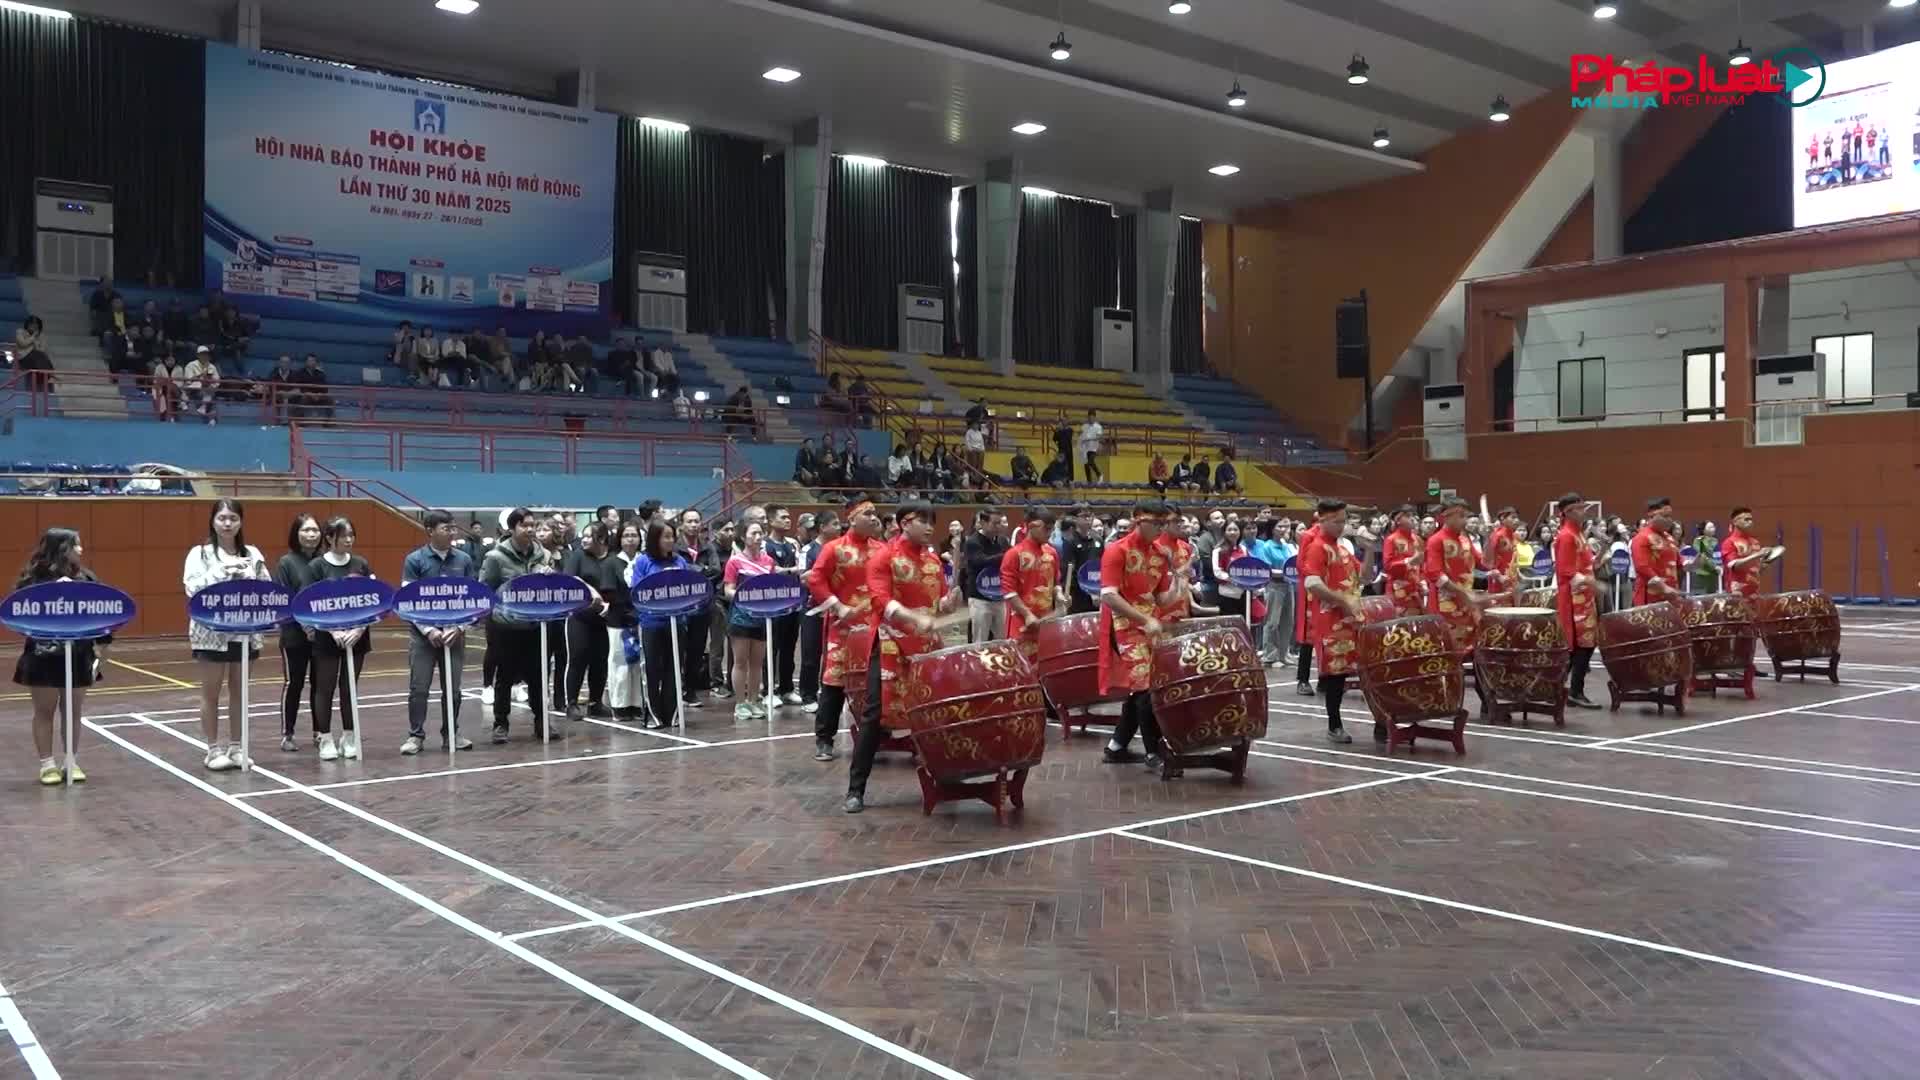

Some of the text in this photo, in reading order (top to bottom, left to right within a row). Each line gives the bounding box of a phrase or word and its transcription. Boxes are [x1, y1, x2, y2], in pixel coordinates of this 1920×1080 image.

[370, 129, 486, 162] HỘI KHỎE
[255, 136, 581, 199] HỘI NHÀ BÁO THÀNH PHỐ HÀ NỘI MỞ RỘNG
[340, 175, 511, 214] LẦN THỨ 30 NĂM 2025
[201, 590, 288, 609] TẠP CHÍ ĐỜI SỐNG
[419, 585, 435, 596] BAN
[436, 583, 453, 596] LIÊN
[638, 583, 707, 604] TẠP CHÍ NGÀY NAY
[12, 596, 123, 616] BÁO TIỀN PHONG
[309, 592, 380, 613] VNEXPRESS
[465, 597, 476, 609] HÀ
[213, 608, 277, 625] & PHÁP LUẬT
